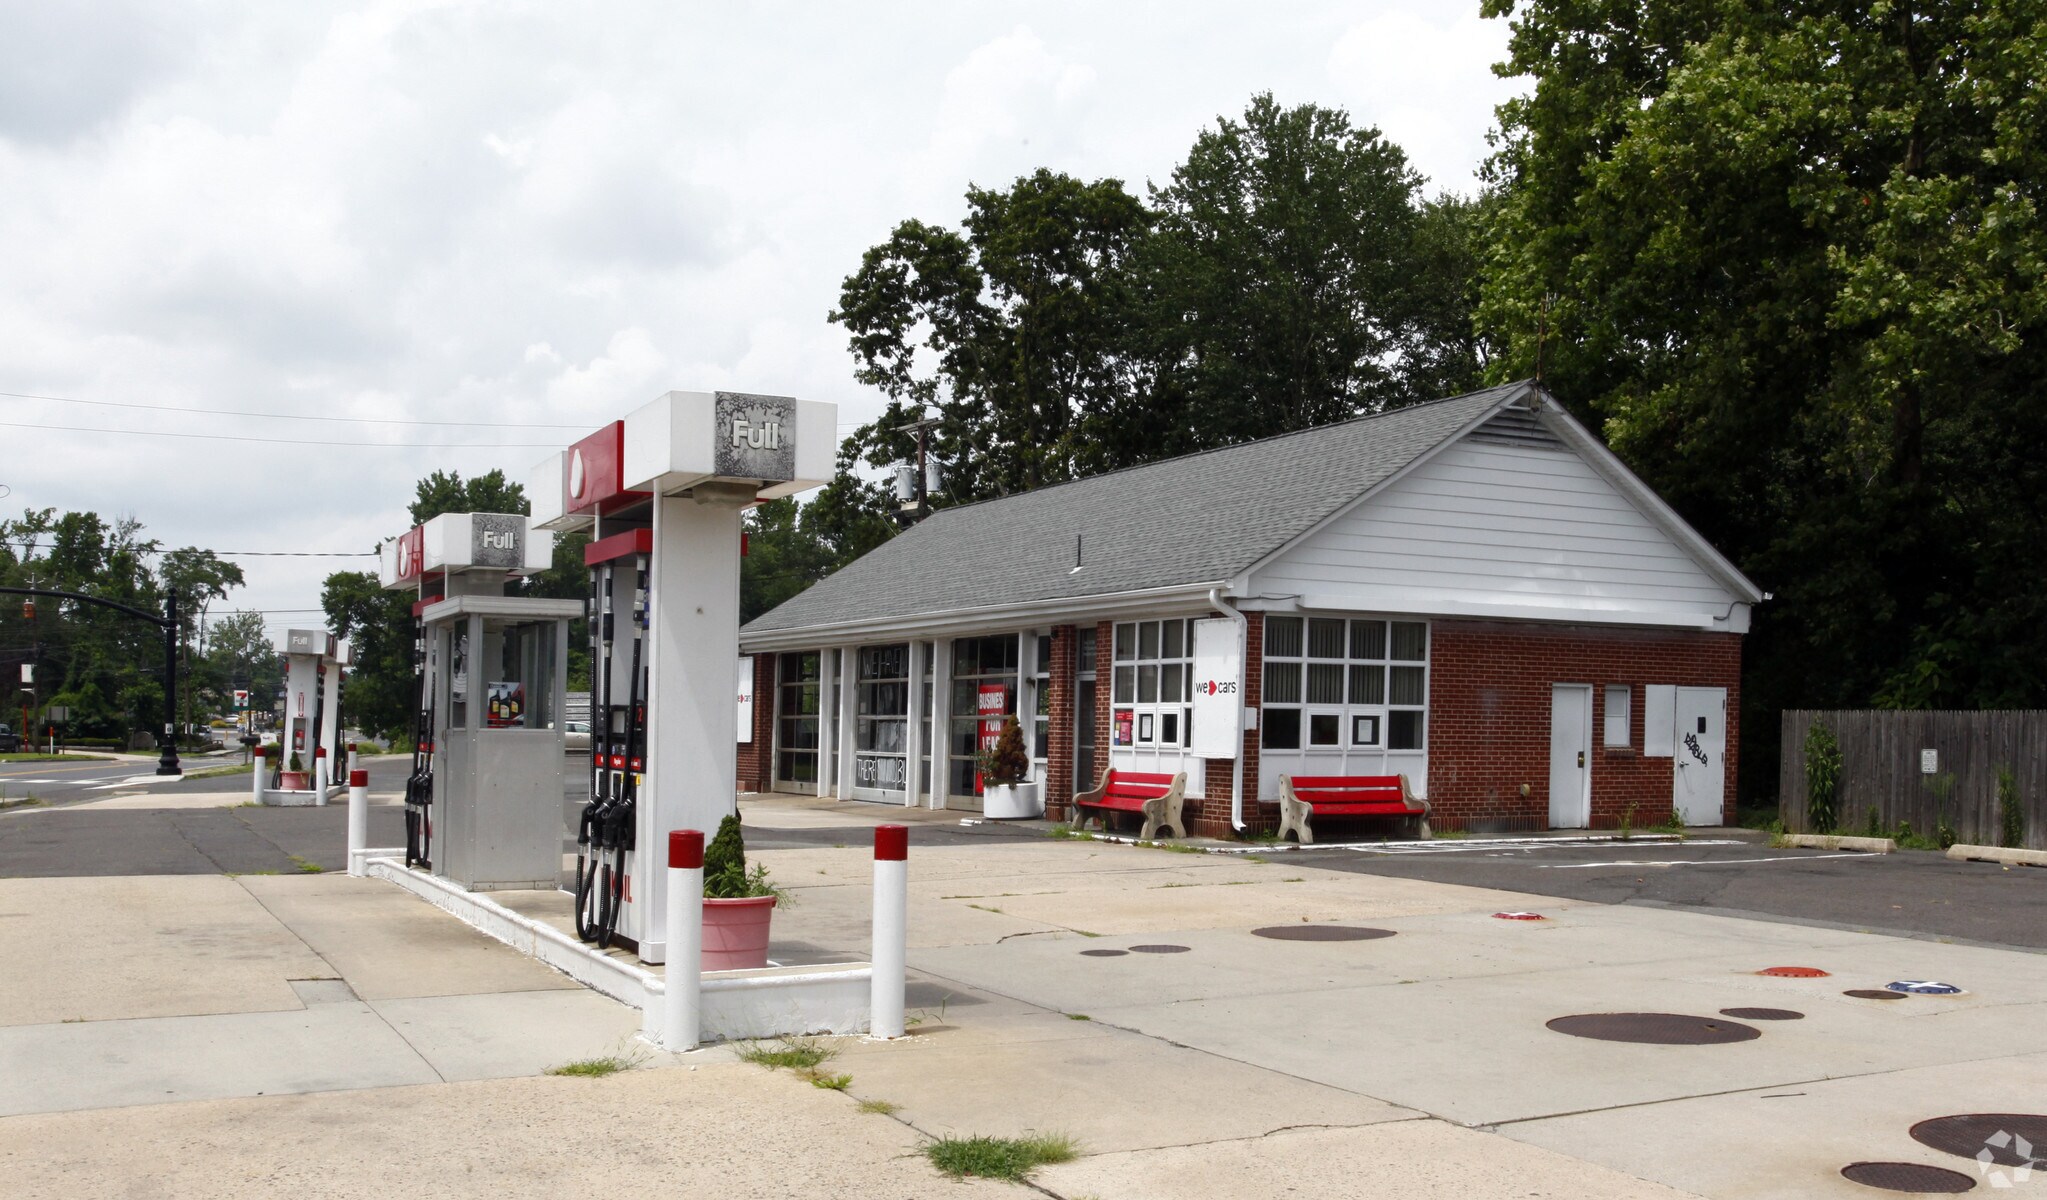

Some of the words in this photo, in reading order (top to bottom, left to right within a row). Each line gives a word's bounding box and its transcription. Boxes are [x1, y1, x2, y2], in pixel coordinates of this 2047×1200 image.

[733, 420, 779, 450] Full
[483, 531, 514, 549] Full
[292, 636, 308, 645] Full
[1195, 682, 1208, 694] we
[1217, 681, 1237, 694] cars
[979, 692, 1004, 710] BUSINES
[985, 713, 1001, 732] FOR
